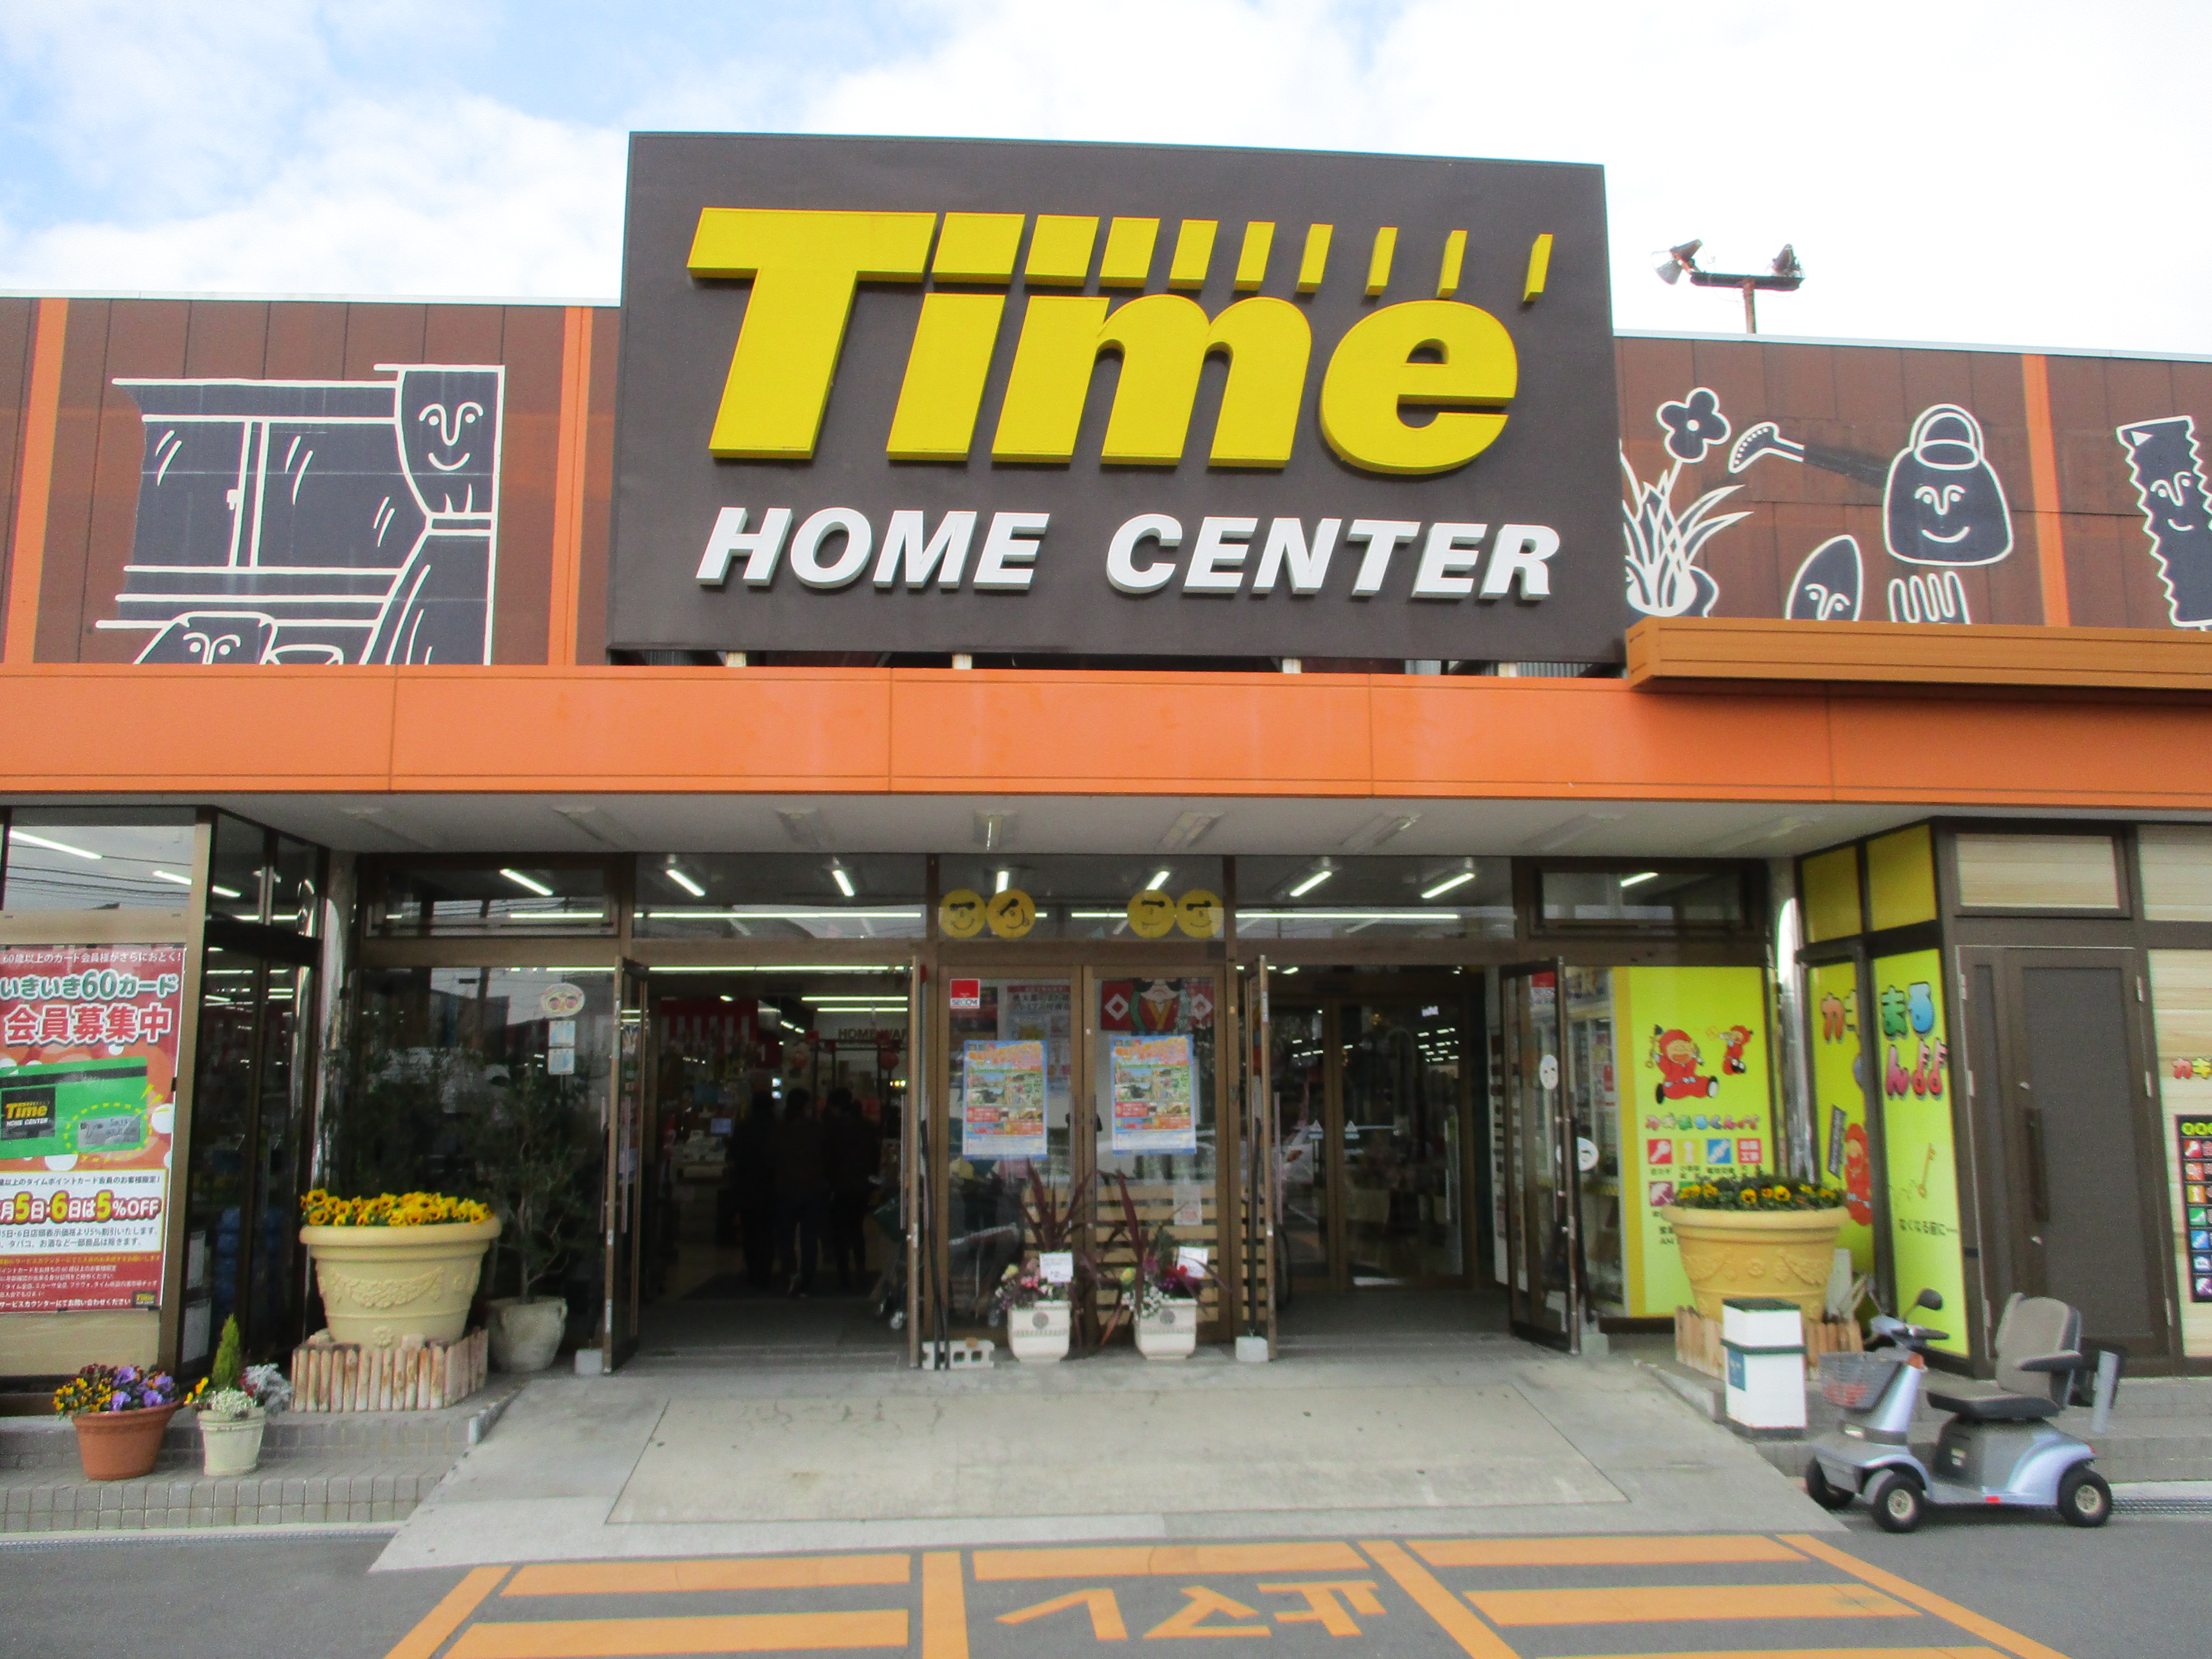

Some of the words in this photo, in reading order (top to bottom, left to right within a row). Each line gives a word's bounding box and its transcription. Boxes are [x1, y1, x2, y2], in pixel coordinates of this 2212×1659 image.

[687, 206, 1553, 475] Time
[695, 506, 1050, 591] HOME
[1105, 514, 1562, 603] CENTER
[0, 969, 179, 1000] いきいき60カード
[4, 1002, 172, 1046] 会員募集中
[5, 1101, 49, 1119] Time
[0, 1191, 160, 1222] 月5日・6日は5%OFF
[994, 1580, 1386, 1641] 止マレ
